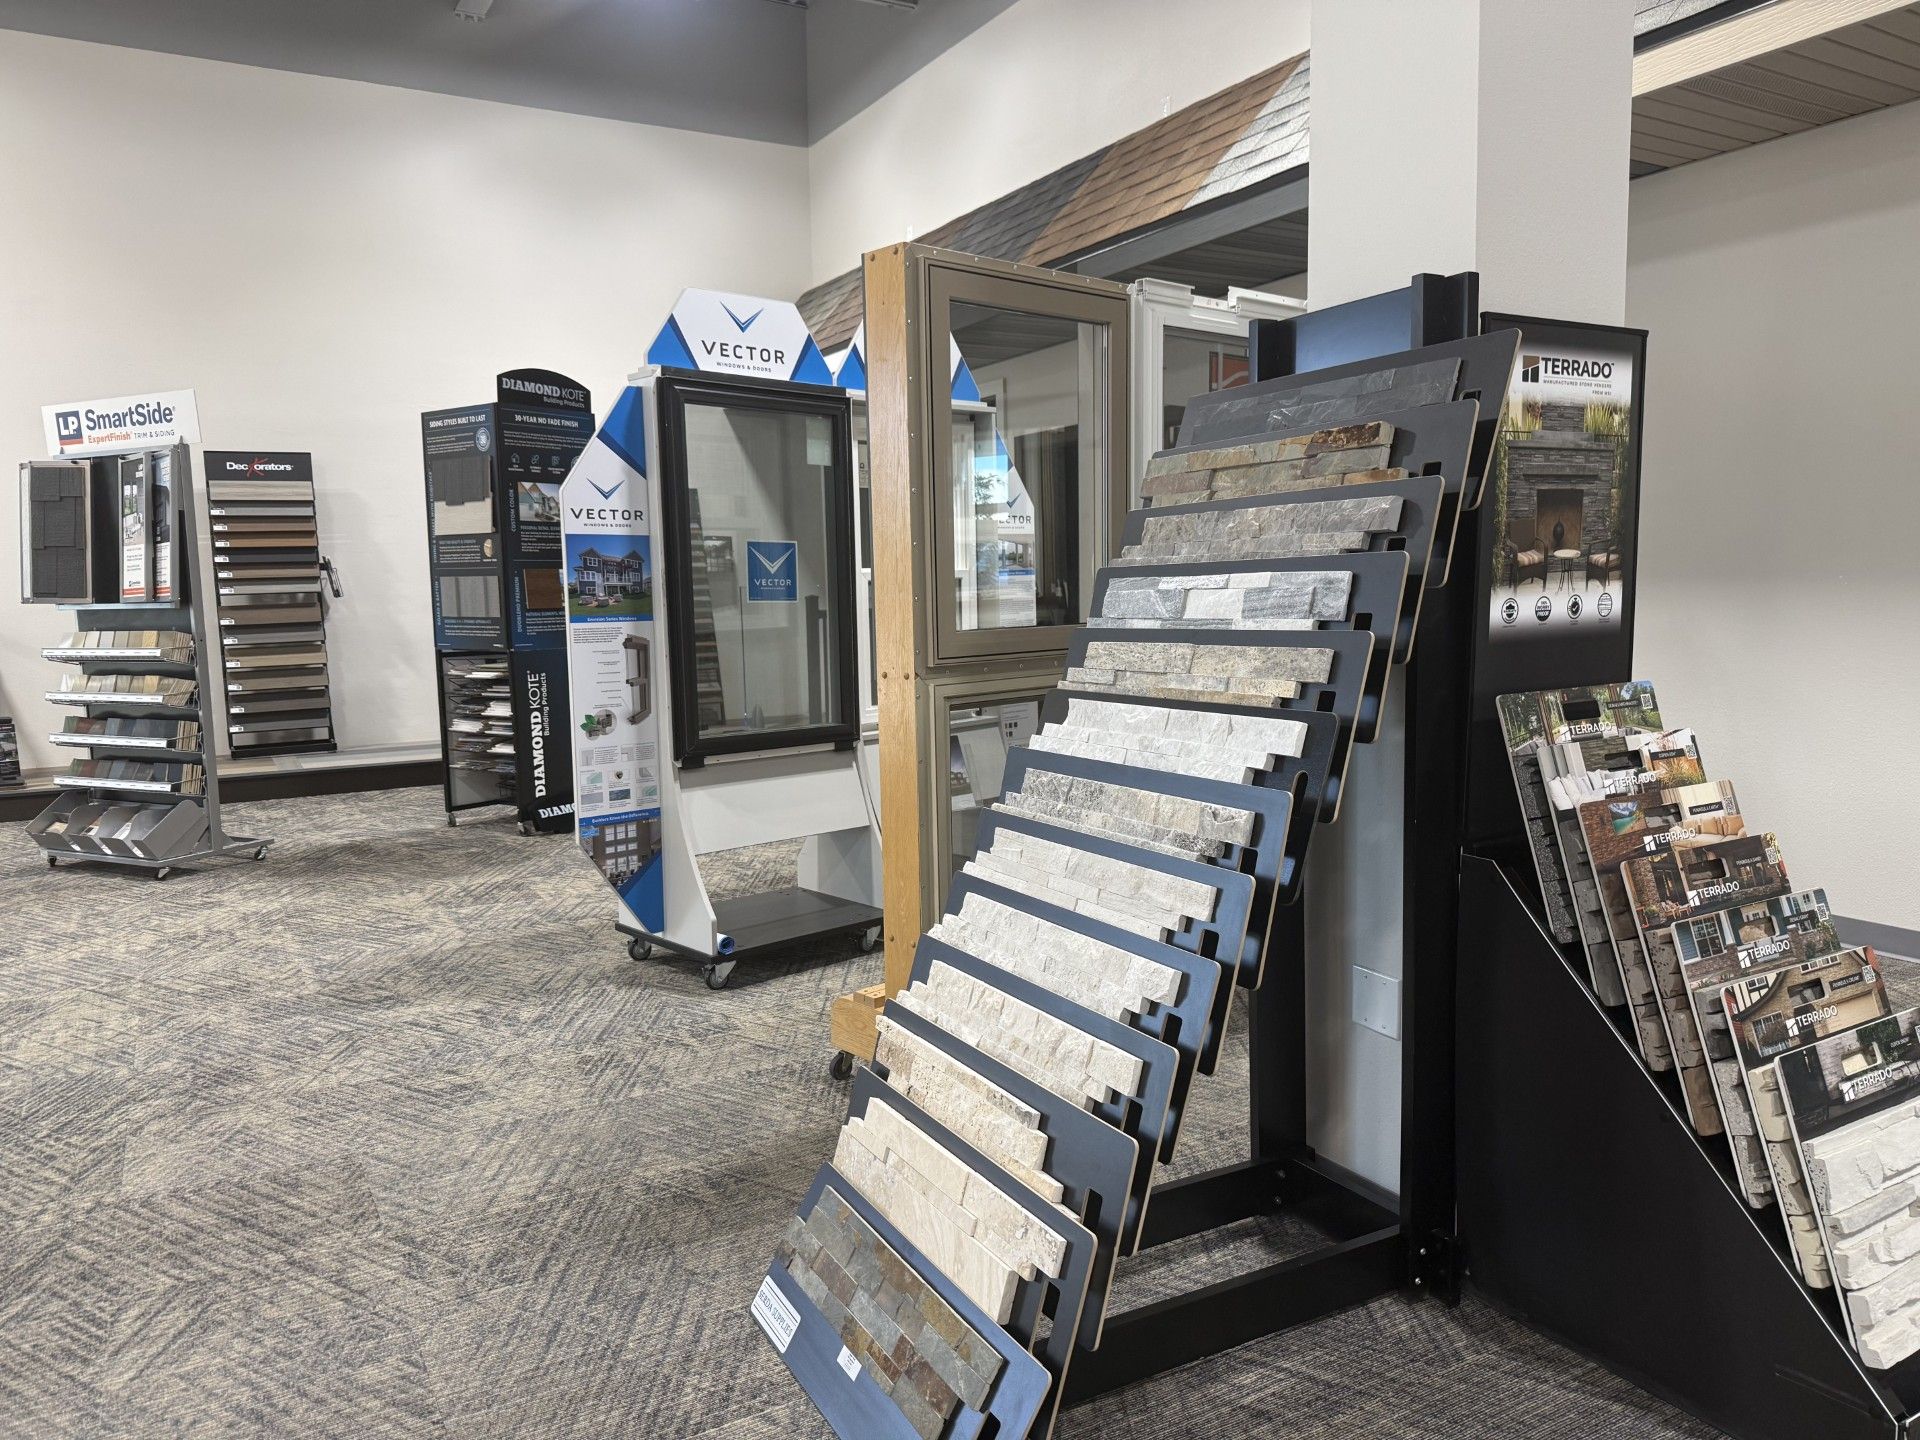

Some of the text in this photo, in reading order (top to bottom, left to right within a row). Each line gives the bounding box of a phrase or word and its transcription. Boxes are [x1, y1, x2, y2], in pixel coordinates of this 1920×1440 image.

[701, 340, 784, 364] VECTOR
[1541, 357, 1612, 378] TERRADO
[502, 378, 584, 402] DIAMOND KOTE
[544, 397, 584, 408] Building Products
[58, 402, 173, 435] LP SmartSide
[514, 414, 537, 423] 30-YEAR
[88, 432, 131, 444] ExpertFinish
[570, 508, 644, 521] VECTOR
[529, 673, 546, 798] DIAMOND KOTE
[1570, 722, 1612, 735] TERRADO
[1615, 773, 1656, 788] TERRADO
[1653, 828, 1696, 844] TERRADO
[1698, 881, 1740, 898] TERRADO
[1748, 940, 1790, 960] TERRADO
[1796, 1005, 1838, 1027] TERRADO
[1853, 1067, 1892, 1091] TERRADO
